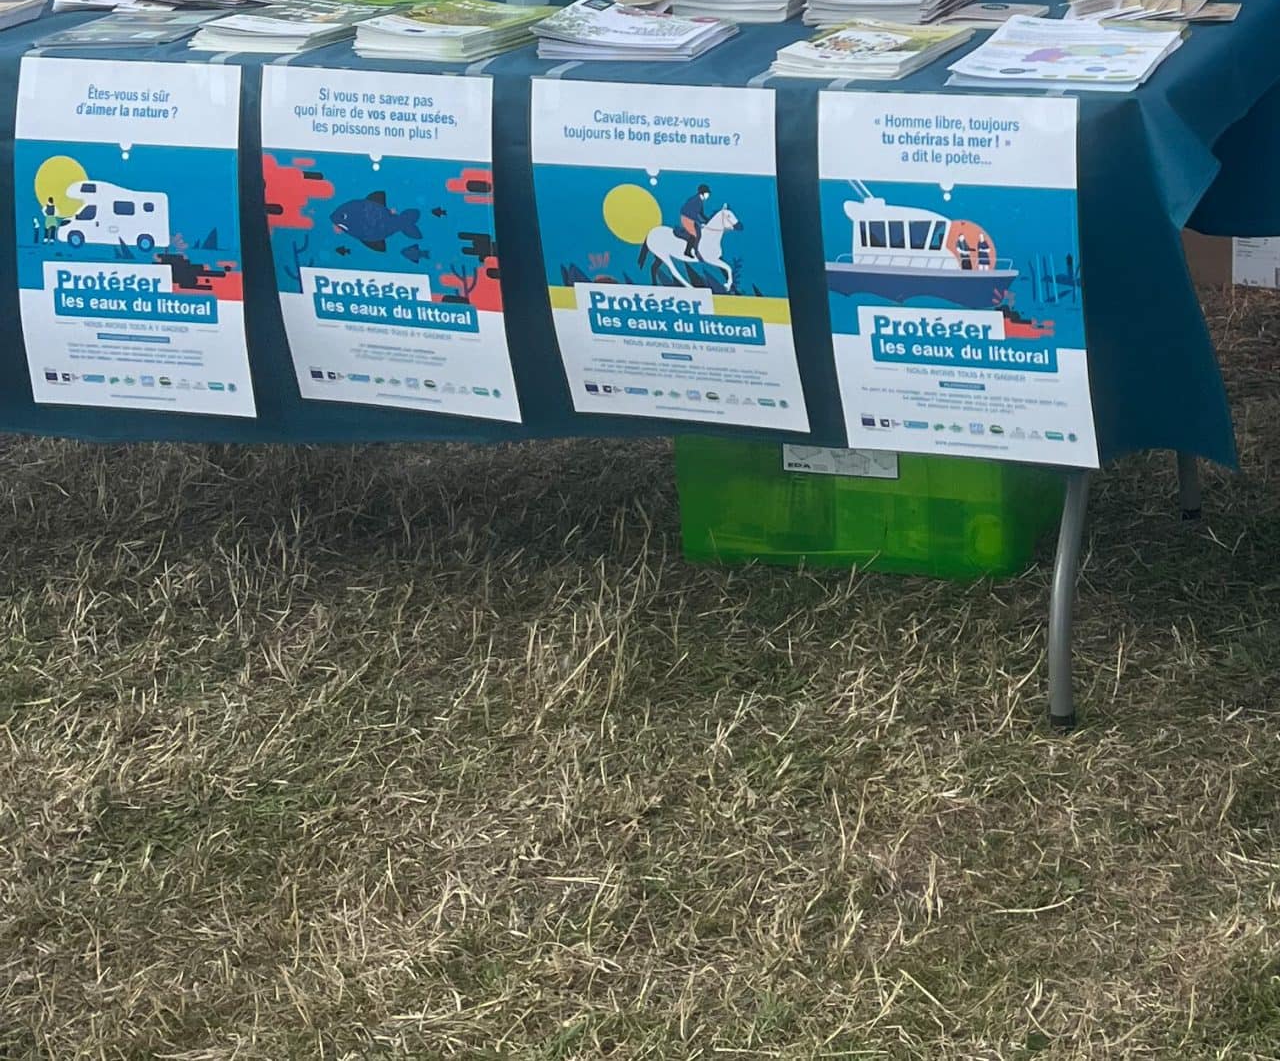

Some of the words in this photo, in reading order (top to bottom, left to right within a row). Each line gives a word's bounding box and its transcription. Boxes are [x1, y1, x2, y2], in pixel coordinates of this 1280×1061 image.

[88, 85, 138, 102] Êtes-vous
[141, 88, 150, 102] si
[152, 89, 170, 103] sûr
[319, 88, 330, 102] Si
[333, 91, 359, 103] vous
[362, 93, 376, 105] ne
[379, 94, 409, 107] savez
[413, 95, 433, 109] pas
[76, 102, 117, 116] d'aimer
[120, 104, 129, 117] la
[133, 106, 169, 118] nature
[294, 103, 318, 117] quoi
[321, 104, 347, 118] faire
[350, 105, 365, 119] de
[367, 108, 386, 121] vos
[390, 110, 417, 123] eaux
[420, 110, 458, 127] usées,
[594, 109, 651, 127] Cavaliers,
[654, 115, 711, 128] avez-vous
[312, 120, 328, 133] les
[332, 122, 381, 138] poissons
[384, 125, 405, 137] non
[408, 124, 432, 141] plus
[885, 114, 932, 129] Homme
[934, 115, 966, 132] libre,
[969, 118, 1020, 133] toujours
[564, 126, 611, 142] toujours
[614, 127, 626, 140] le
[628, 128, 650, 142] bon
[653, 130, 687, 145] geste
[690, 133, 731, 145] nature
[882, 132, 895, 145] tu
[898, 131, 950, 147] chériras
[952, 132, 965, 147] la
[968, 135, 993, 148] mer
[901, 152, 909, 162] a
[912, 149, 929, 163] dit
[931, 149, 942, 163] le
[945, 151, 993, 167] poète...
[56, 270, 161, 293] Protéger
[314, 275, 419, 300] Protéger
[61, 293, 84, 308] les
[89, 297, 127, 311] eaux
[133, 297, 152, 312] du
[157, 298, 211, 316] littoral
[321, 298, 345, 313] les
[350, 303, 387, 318] eaux
[392, 304, 412, 319] du
[417, 305, 471, 325] littoral
[589, 290, 702, 315] Protéger
[596, 313, 622, 328] les
[627, 317, 668, 332] eaux
[673, 318, 694, 334] du
[699, 320, 757, 338] littoral
[873, 315, 992, 340] Protéger
[880, 340, 906, 355] les
[912, 343, 954, 359] eaux
[960, 344, 982, 360] du
[988, 345, 1050, 365] littoral
